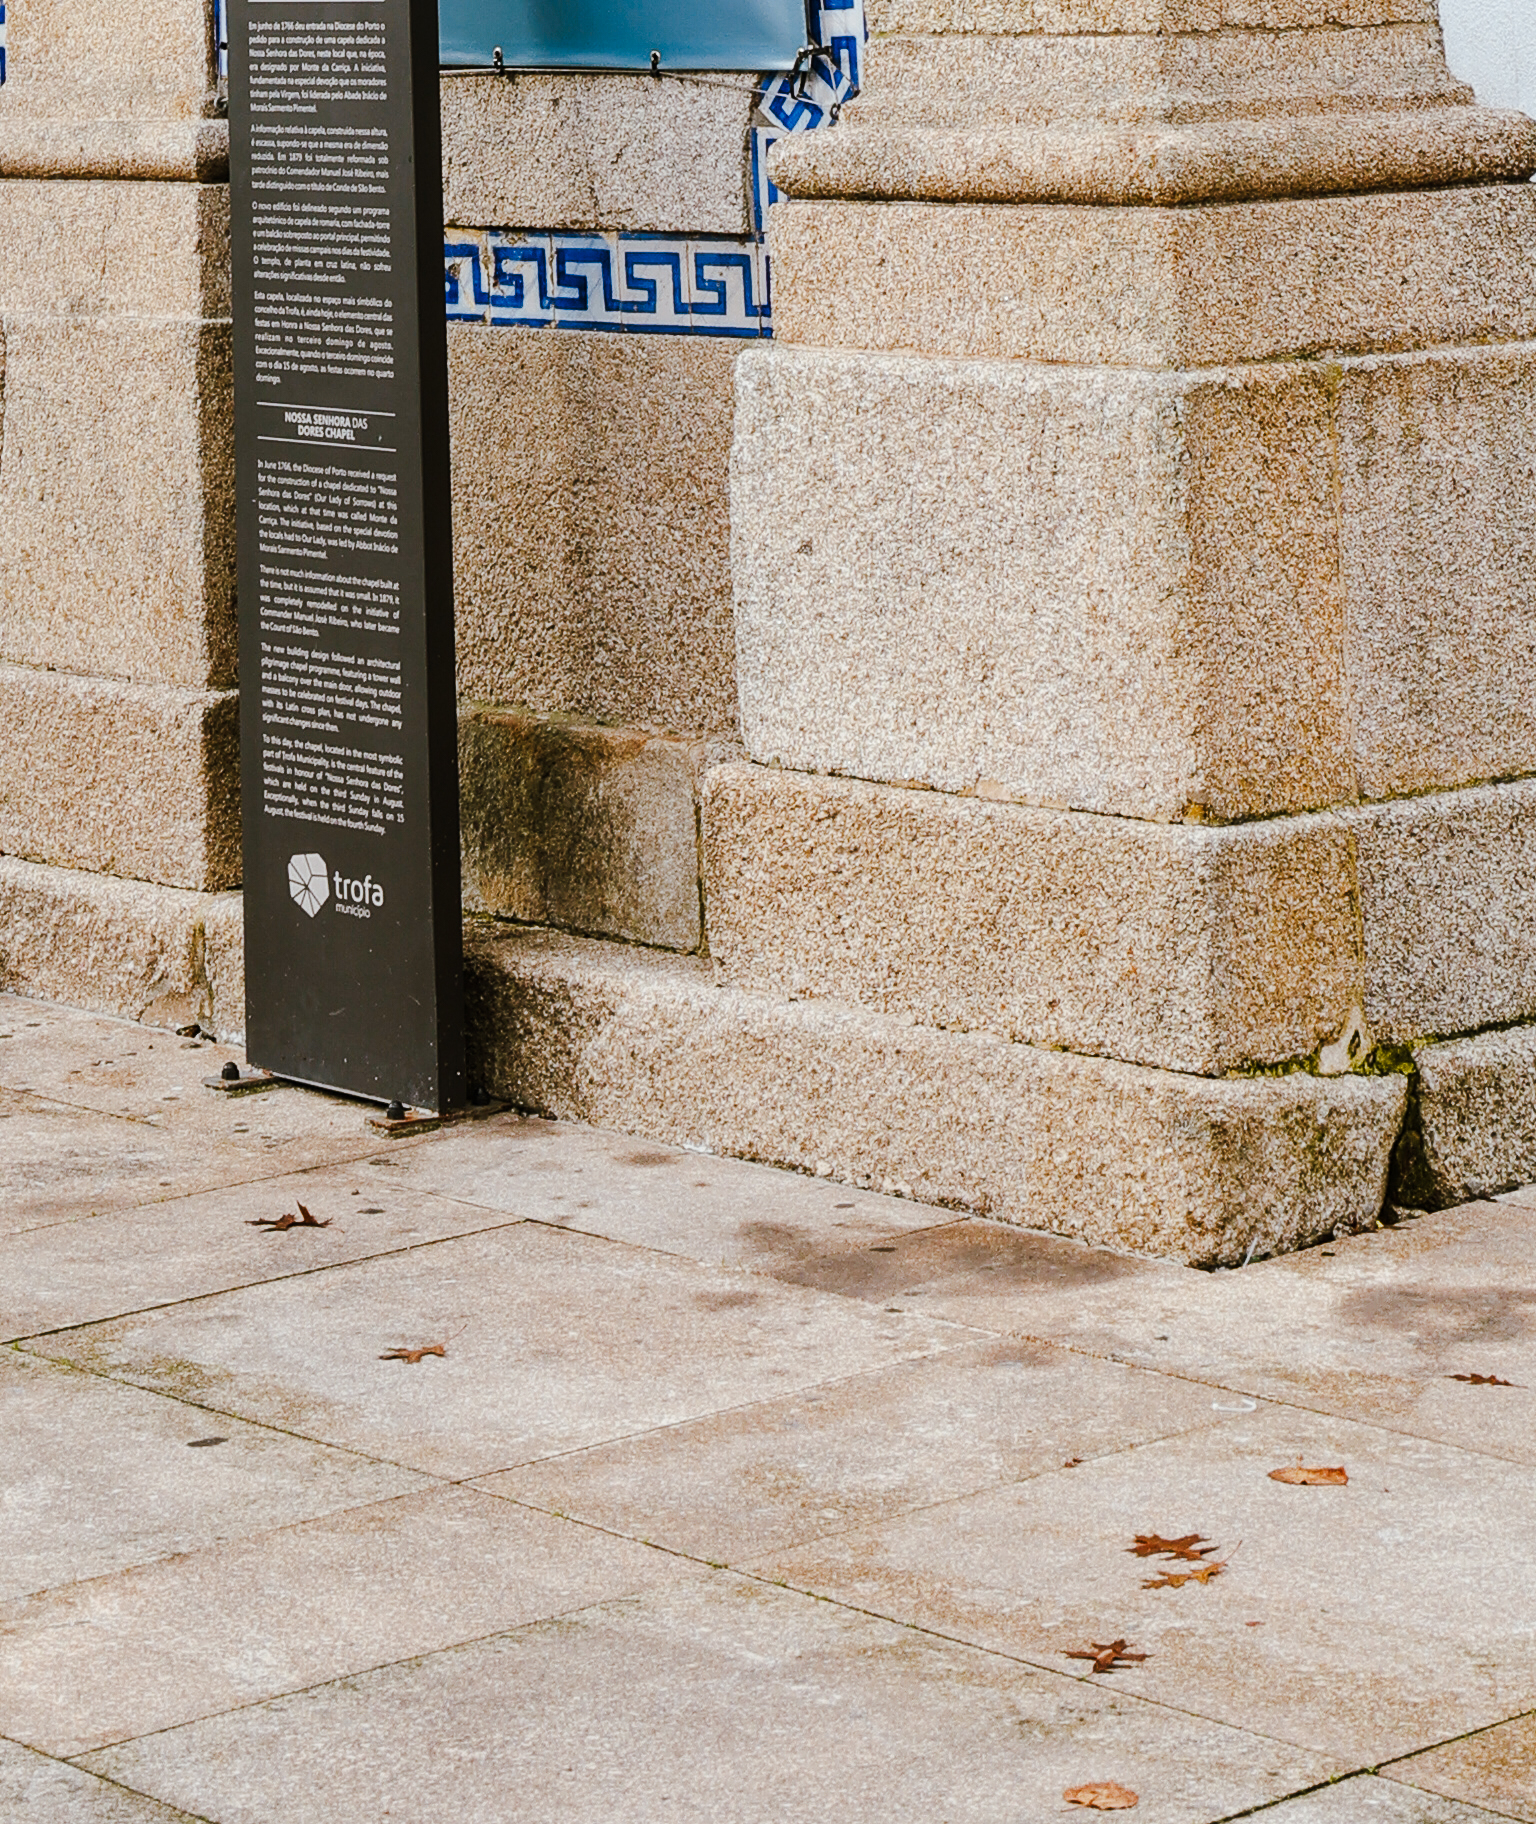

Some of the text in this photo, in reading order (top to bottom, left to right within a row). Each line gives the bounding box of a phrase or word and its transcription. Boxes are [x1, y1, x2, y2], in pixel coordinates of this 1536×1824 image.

[285, 412, 368, 429] NOSSA SENHORA DAS
[298, 425, 355, 440] DORES CHAPEL
[333, 871, 384, 907] trofa
[336, 903, 371, 919] município
